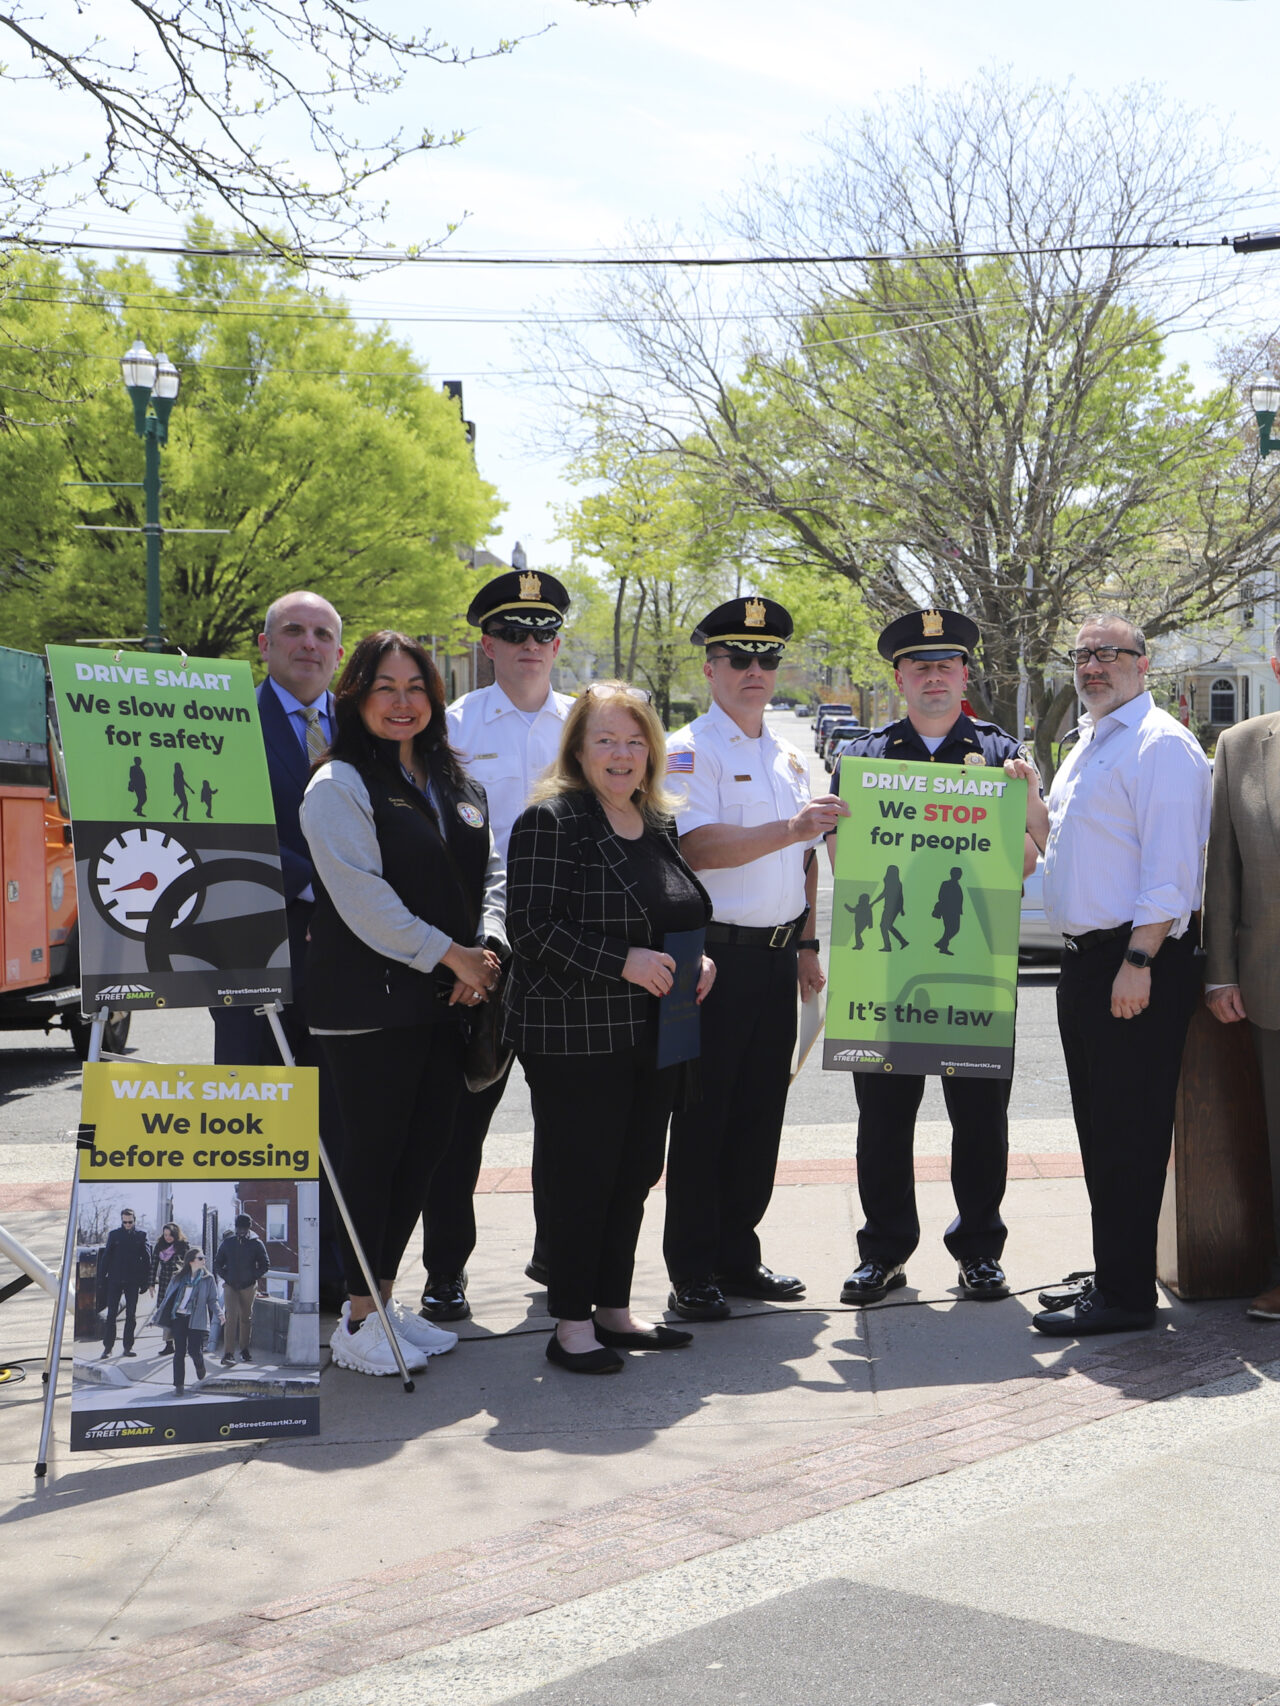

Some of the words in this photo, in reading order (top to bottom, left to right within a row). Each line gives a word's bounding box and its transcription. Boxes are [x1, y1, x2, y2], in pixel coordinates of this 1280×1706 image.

[75, 663, 149, 685] DRIVE
[154, 669, 231, 691] SMART
[66, 692, 110, 714] We
[117, 696, 175, 718] slow
[183, 700, 251, 722] down
[105, 724, 141, 746] for
[149, 728, 224, 755] safety
[862, 772, 928, 792] DRIVE
[933, 777, 1007, 798] SMART
[878, 800, 917, 820] We
[923, 803, 987, 824] STOP
[870, 826, 904, 846] for
[911, 833, 991, 854] people
[95, 992, 125, 1001] STREET
[126, 992, 156, 1000] SMART
[848, 1001, 887, 1022] It's
[895, 1003, 939, 1024] the
[947, 1005, 993, 1026] law
[111, 1080, 195, 1099] WALK
[202, 1082, 293, 1101] SMART
[141, 1113, 190, 1134] We
[200, 1112, 263, 1134] look
[90, 1144, 184, 1167] before
[193, 1143, 309, 1171] crossing
[85, 1429, 121, 1439] STREET
[121, 1427, 155, 1436] SMART
[228, 1418, 307, 1429] BeStreetSmartNJ.org
